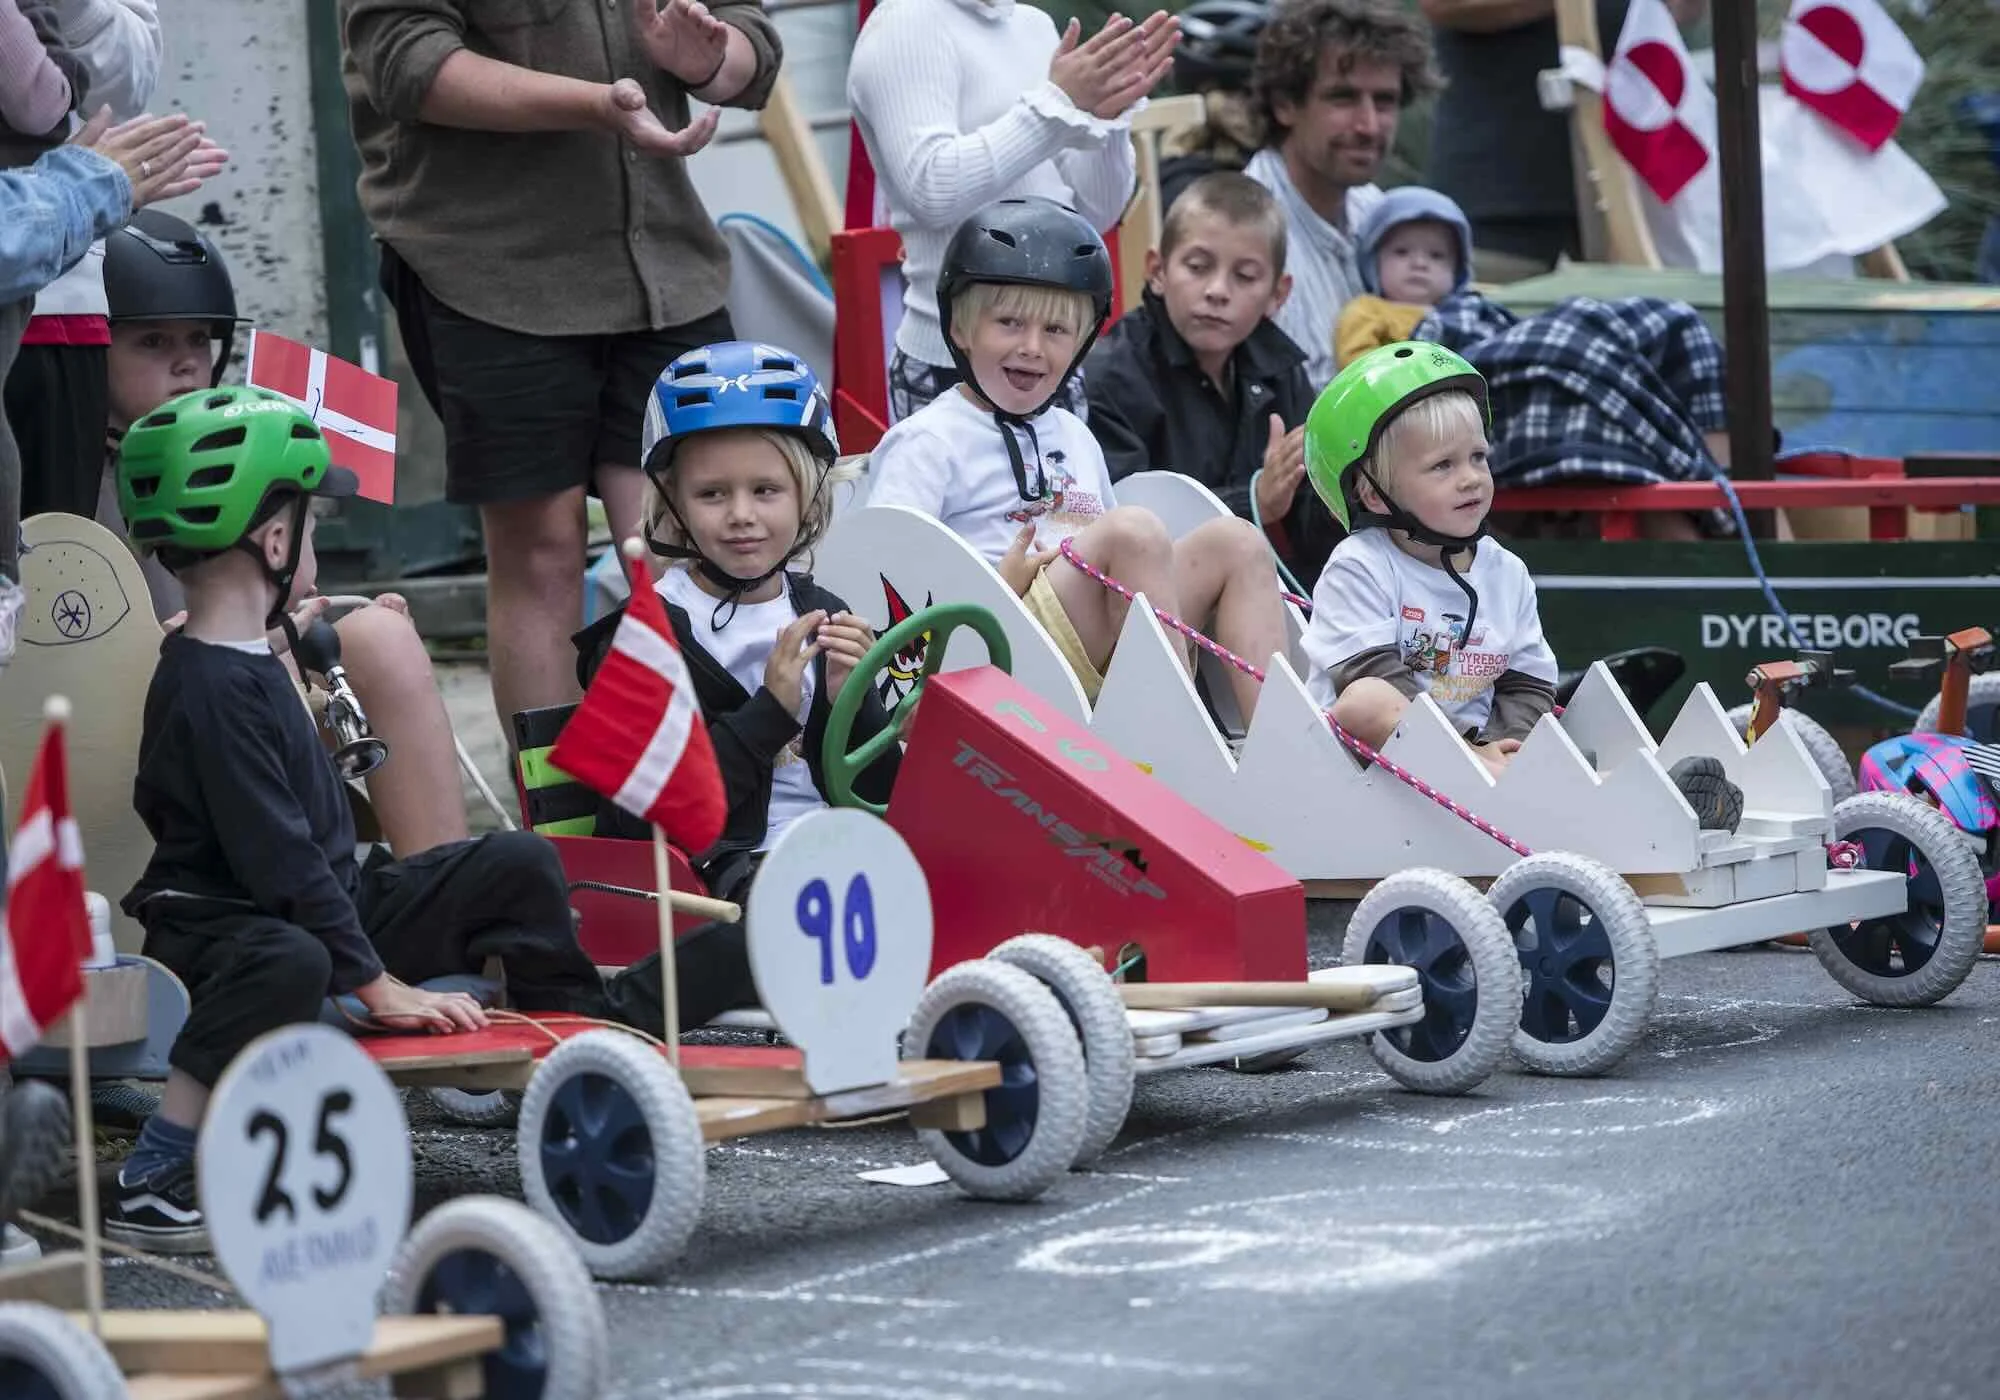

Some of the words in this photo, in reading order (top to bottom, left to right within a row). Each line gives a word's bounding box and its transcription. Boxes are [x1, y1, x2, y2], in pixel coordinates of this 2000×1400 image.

[1701, 613, 1920, 649] DYREBORG
[953, 738, 1167, 898] TRANSALP
[796, 872, 877, 985] 90
[246, 1087, 353, 1223] 25
